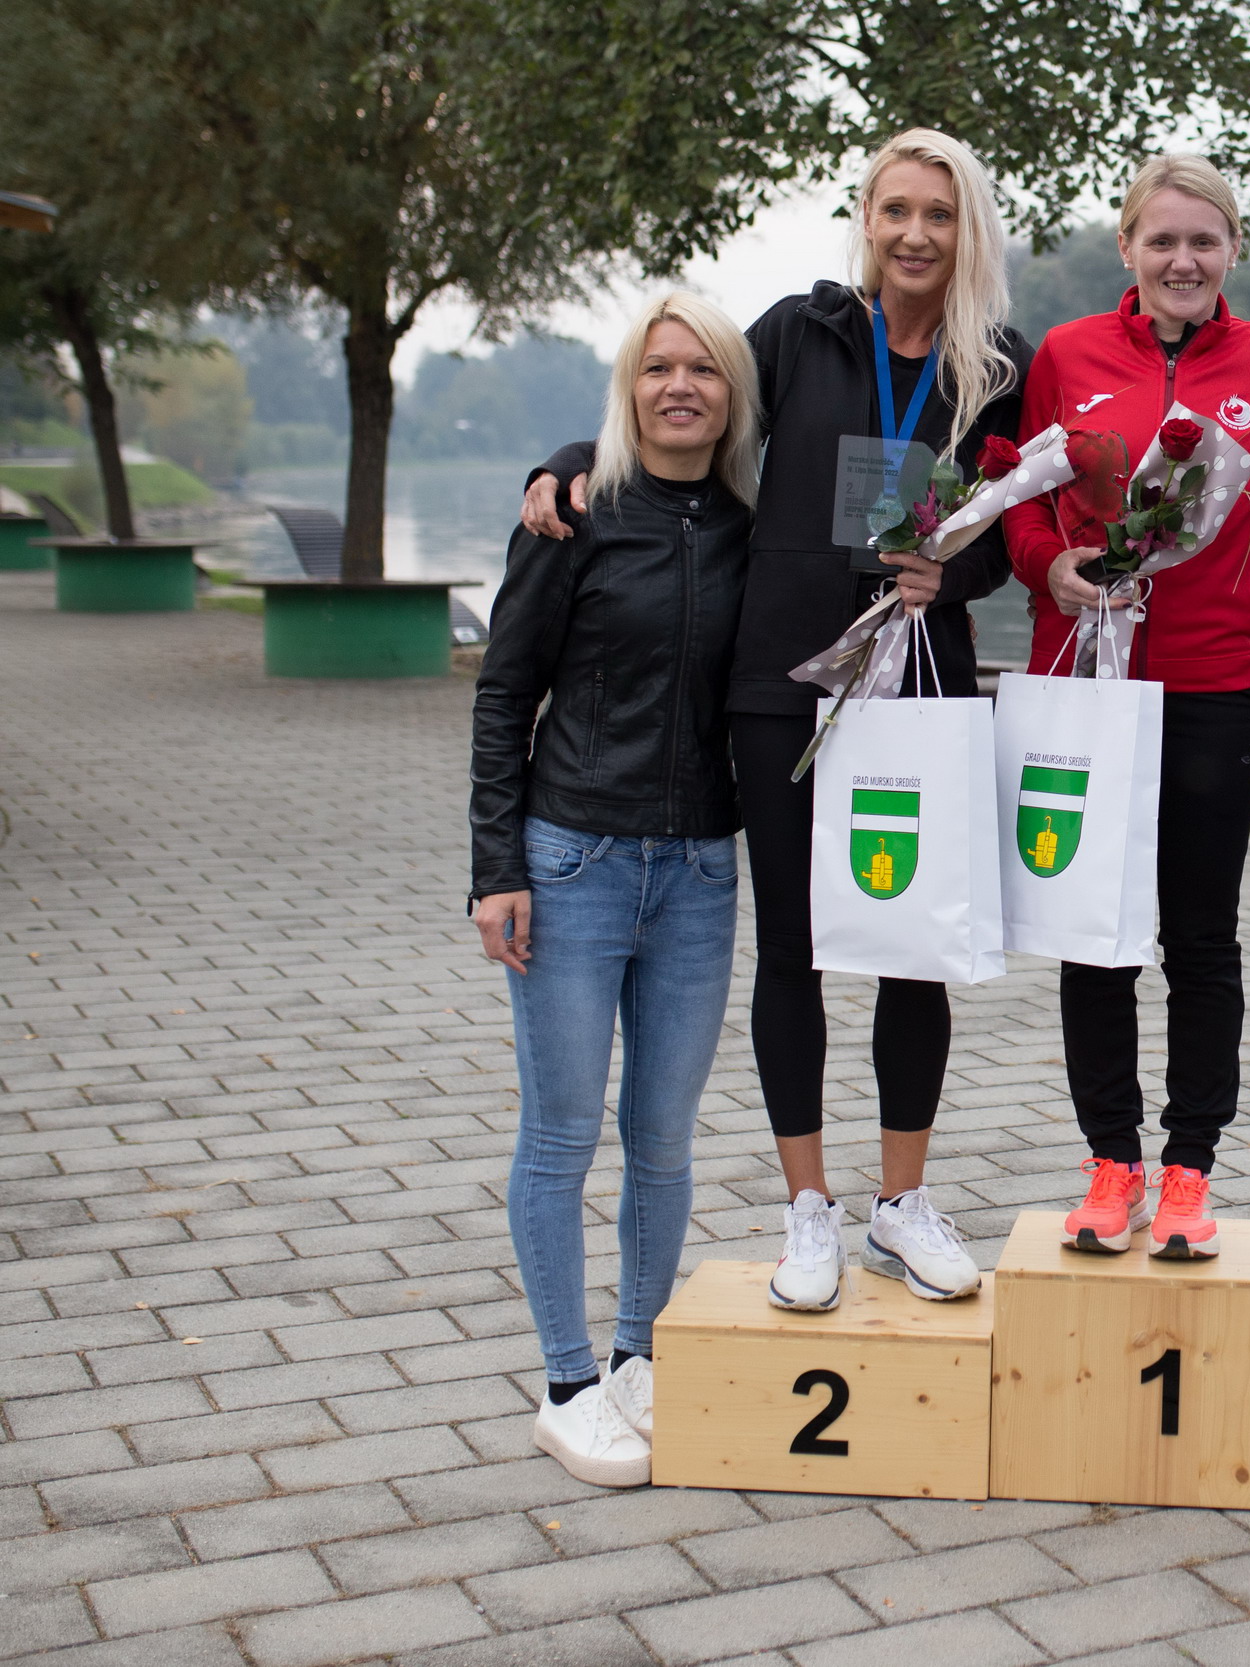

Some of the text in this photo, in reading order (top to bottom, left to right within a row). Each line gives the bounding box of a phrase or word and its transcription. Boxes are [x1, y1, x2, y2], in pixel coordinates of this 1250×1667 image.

[852, 775, 921, 788] GRAD MURSKO SREDIŠĆE
[1025, 751, 1092, 768] GRAD MURSKO SREDIŠĆE
[789, 1368, 850, 1456] 2
[1140, 1348, 1181, 1435] 1
